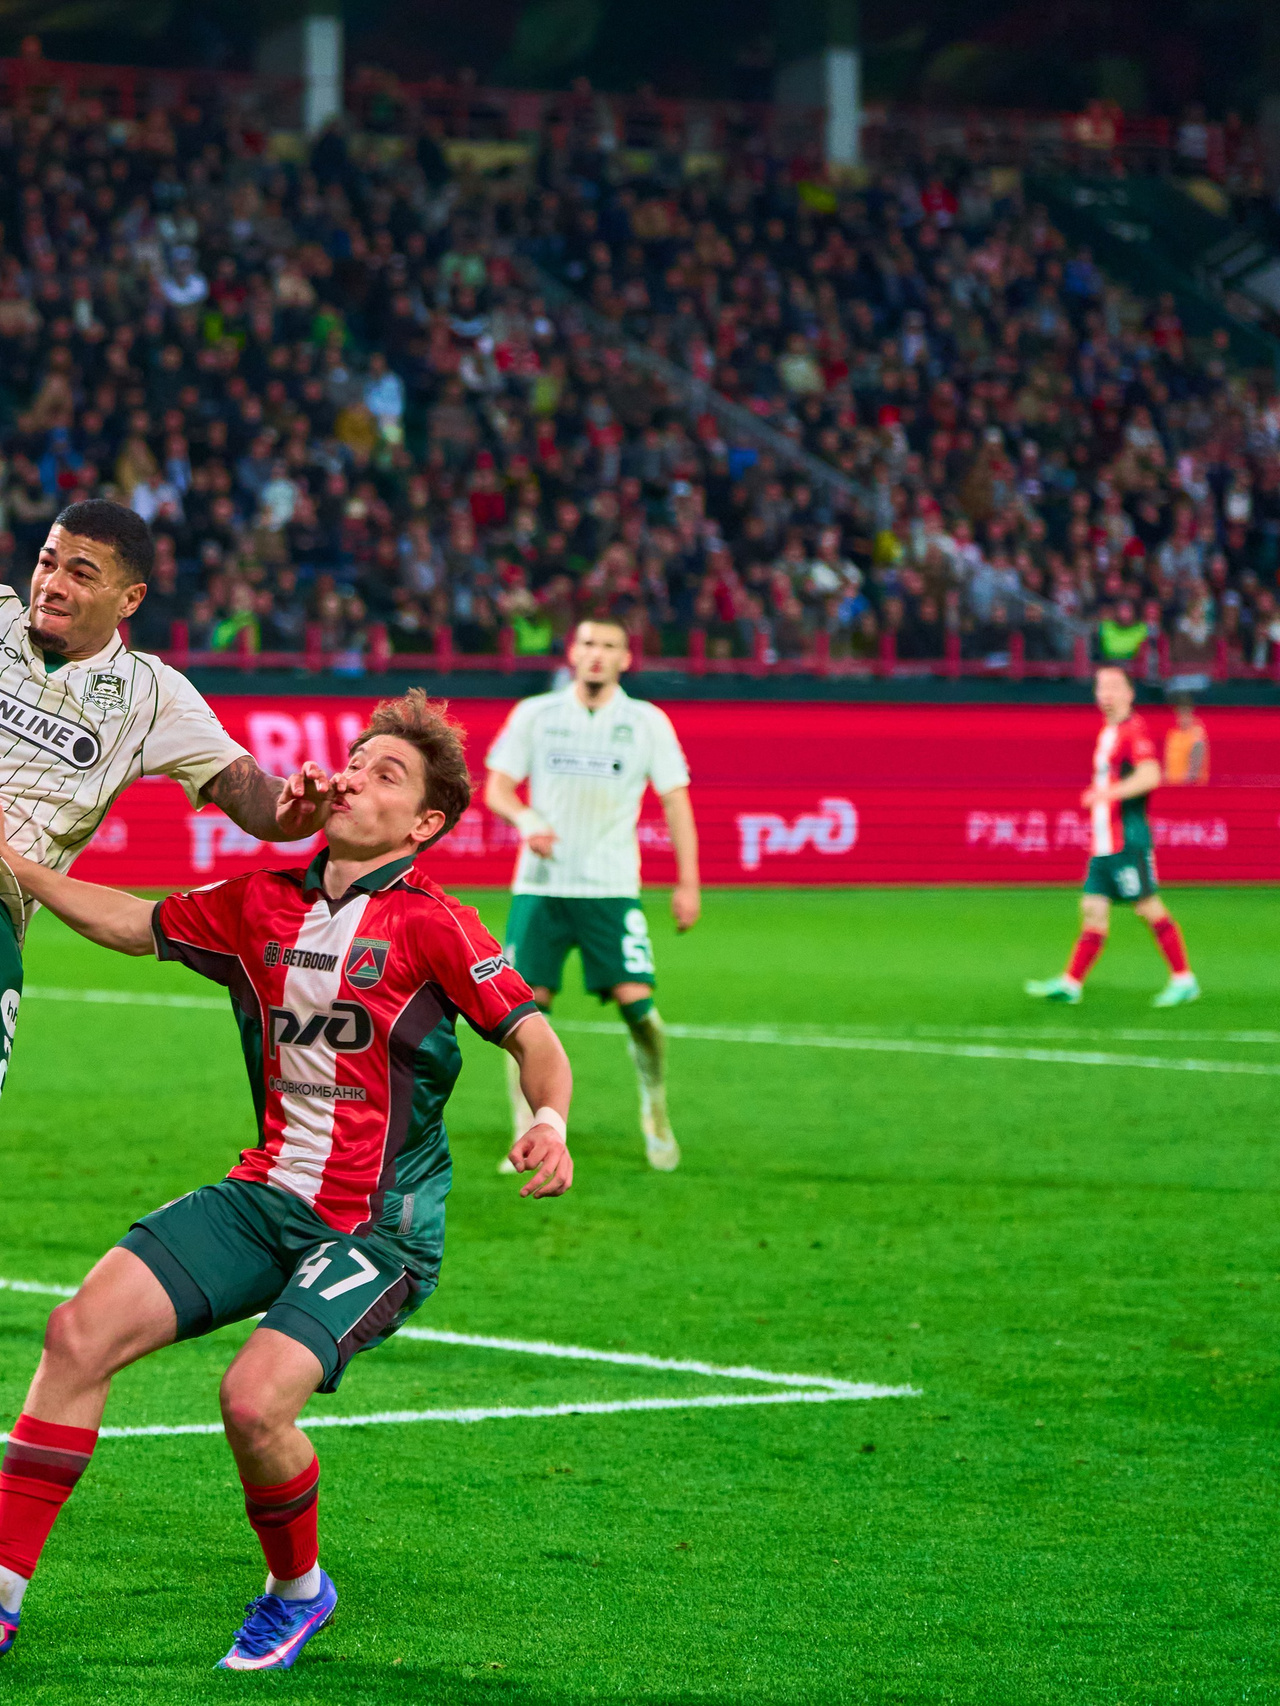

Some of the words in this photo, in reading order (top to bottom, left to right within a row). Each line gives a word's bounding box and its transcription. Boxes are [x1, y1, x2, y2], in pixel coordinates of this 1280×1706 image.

[282, 948, 339, 972] BETBOOM
[276, 1078, 364, 1100] СОВКОМБАНК
[296, 1241, 380, 1301] 47
